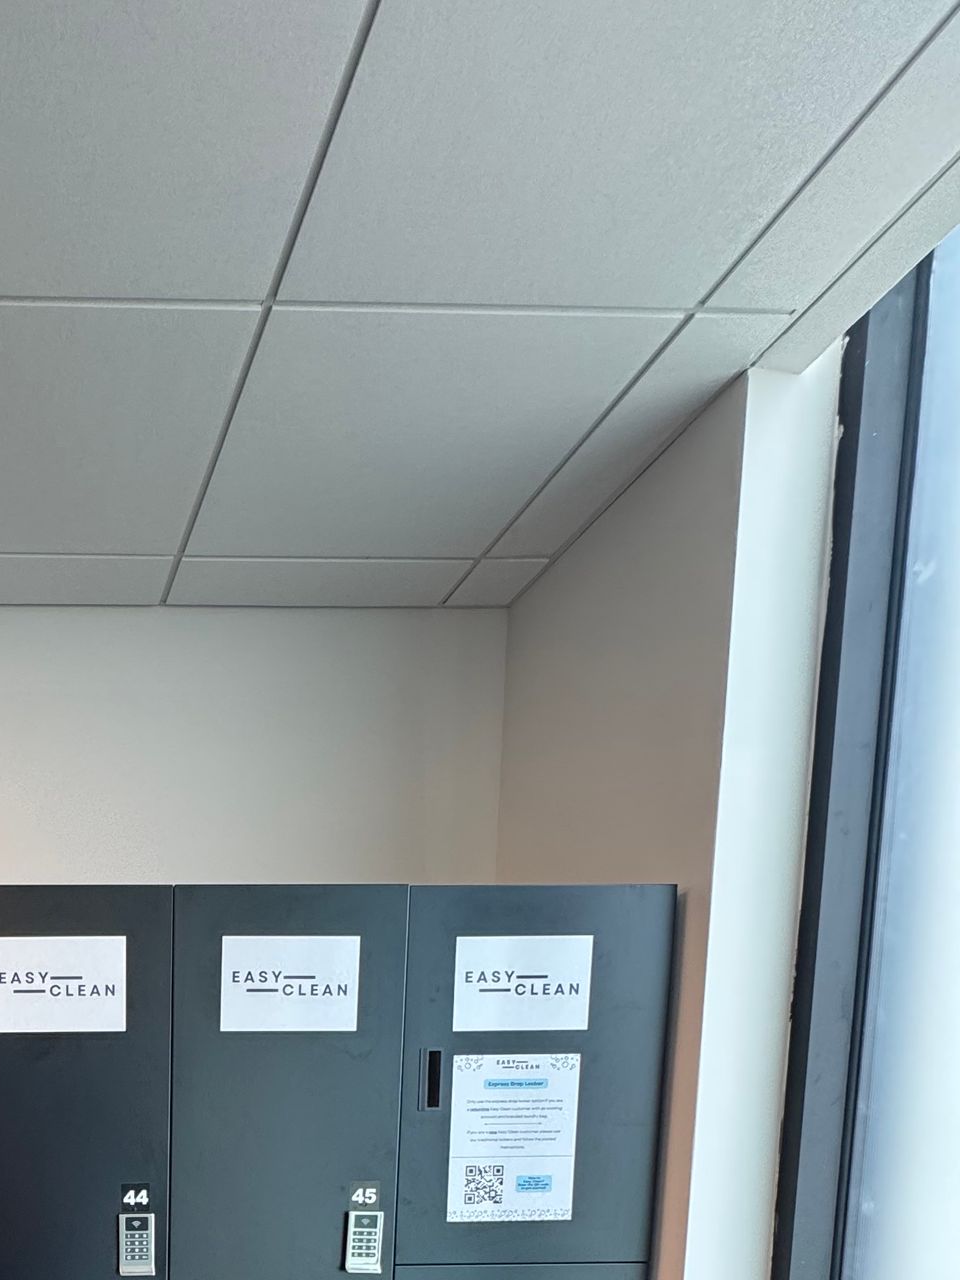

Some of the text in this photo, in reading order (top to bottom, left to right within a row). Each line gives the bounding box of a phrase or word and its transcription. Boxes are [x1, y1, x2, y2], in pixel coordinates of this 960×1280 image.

[231, 970, 282, 983] EASY
[464, 970, 515, 983] EASY
[49, 984, 115, 997] CLEAN
[282, 984, 348, 996] CLEAN
[514, 983, 580, 996] CLEAN
[123, 1190, 149, 1205] 44
[351, 1188, 377, 1204] 45
